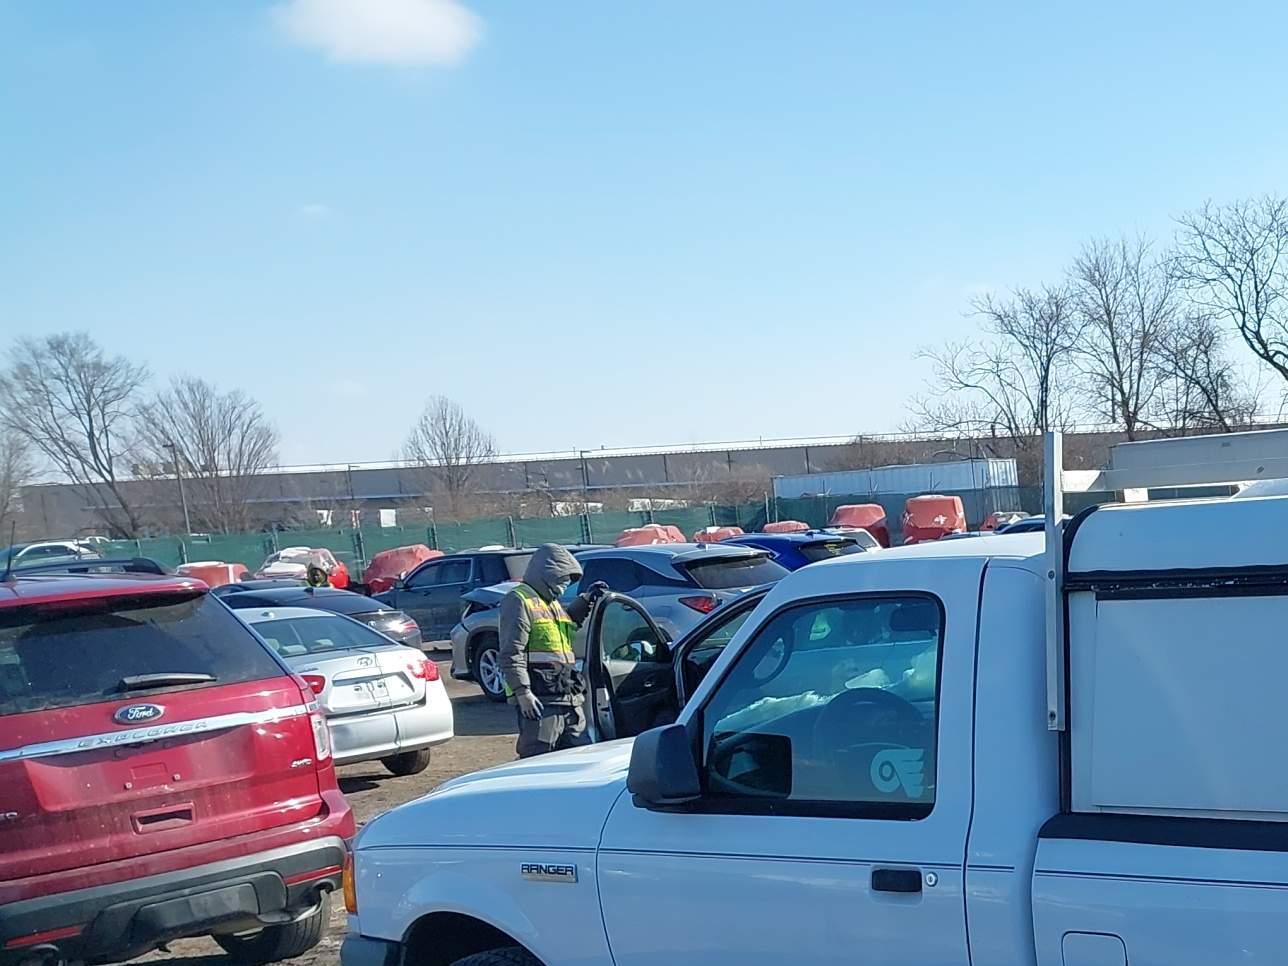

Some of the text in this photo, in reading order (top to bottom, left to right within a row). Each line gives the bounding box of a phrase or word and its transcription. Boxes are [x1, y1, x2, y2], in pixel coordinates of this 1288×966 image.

[127, 705, 155, 720] Ford
[77, 720, 208, 748] EXPLORER
[521, 863, 574, 876] RANGER
